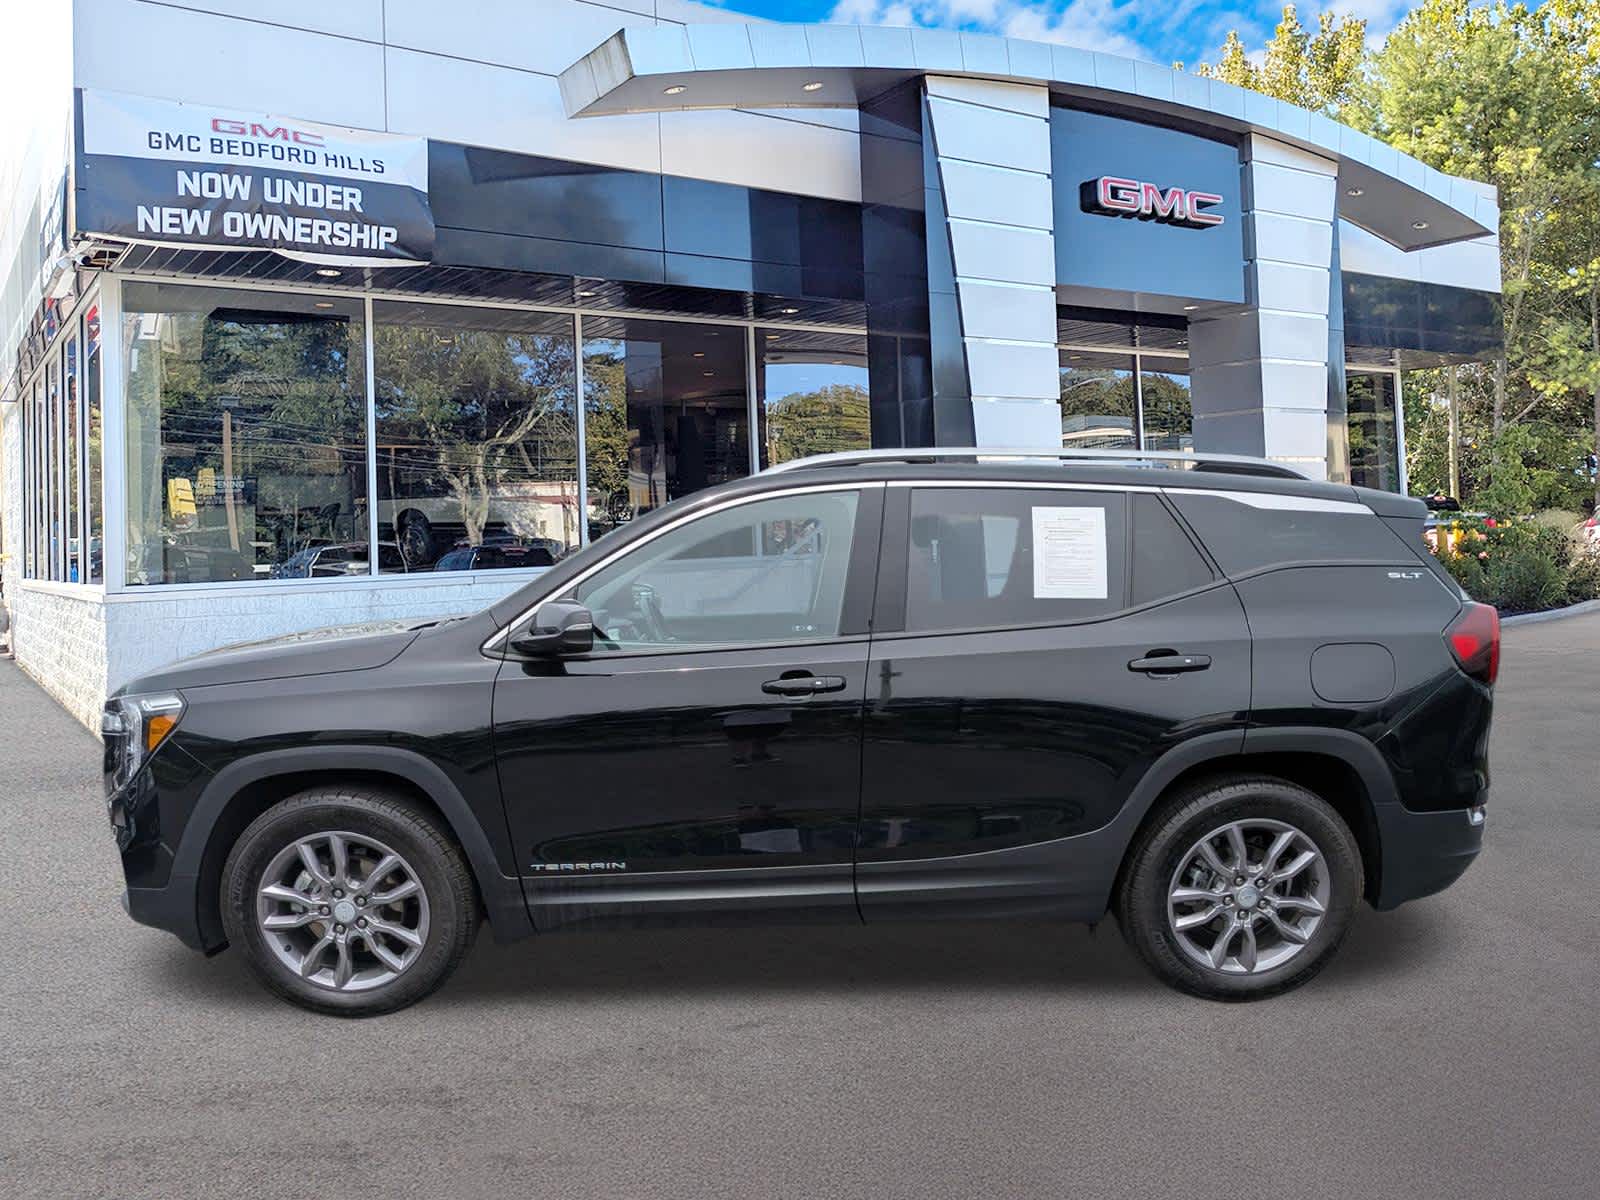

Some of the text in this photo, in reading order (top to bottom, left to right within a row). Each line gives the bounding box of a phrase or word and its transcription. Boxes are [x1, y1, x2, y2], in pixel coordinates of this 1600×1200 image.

[148, 131, 385, 174] GMC BEDFORD HILLS
[211, 118, 326, 148] GMC
[177, 170, 363, 213] NOW UNDER
[1096, 175, 1225, 225] GMC
[136, 205, 398, 250] NEW OWNERSHIP
[530, 862, 626, 871] TERRAIN
